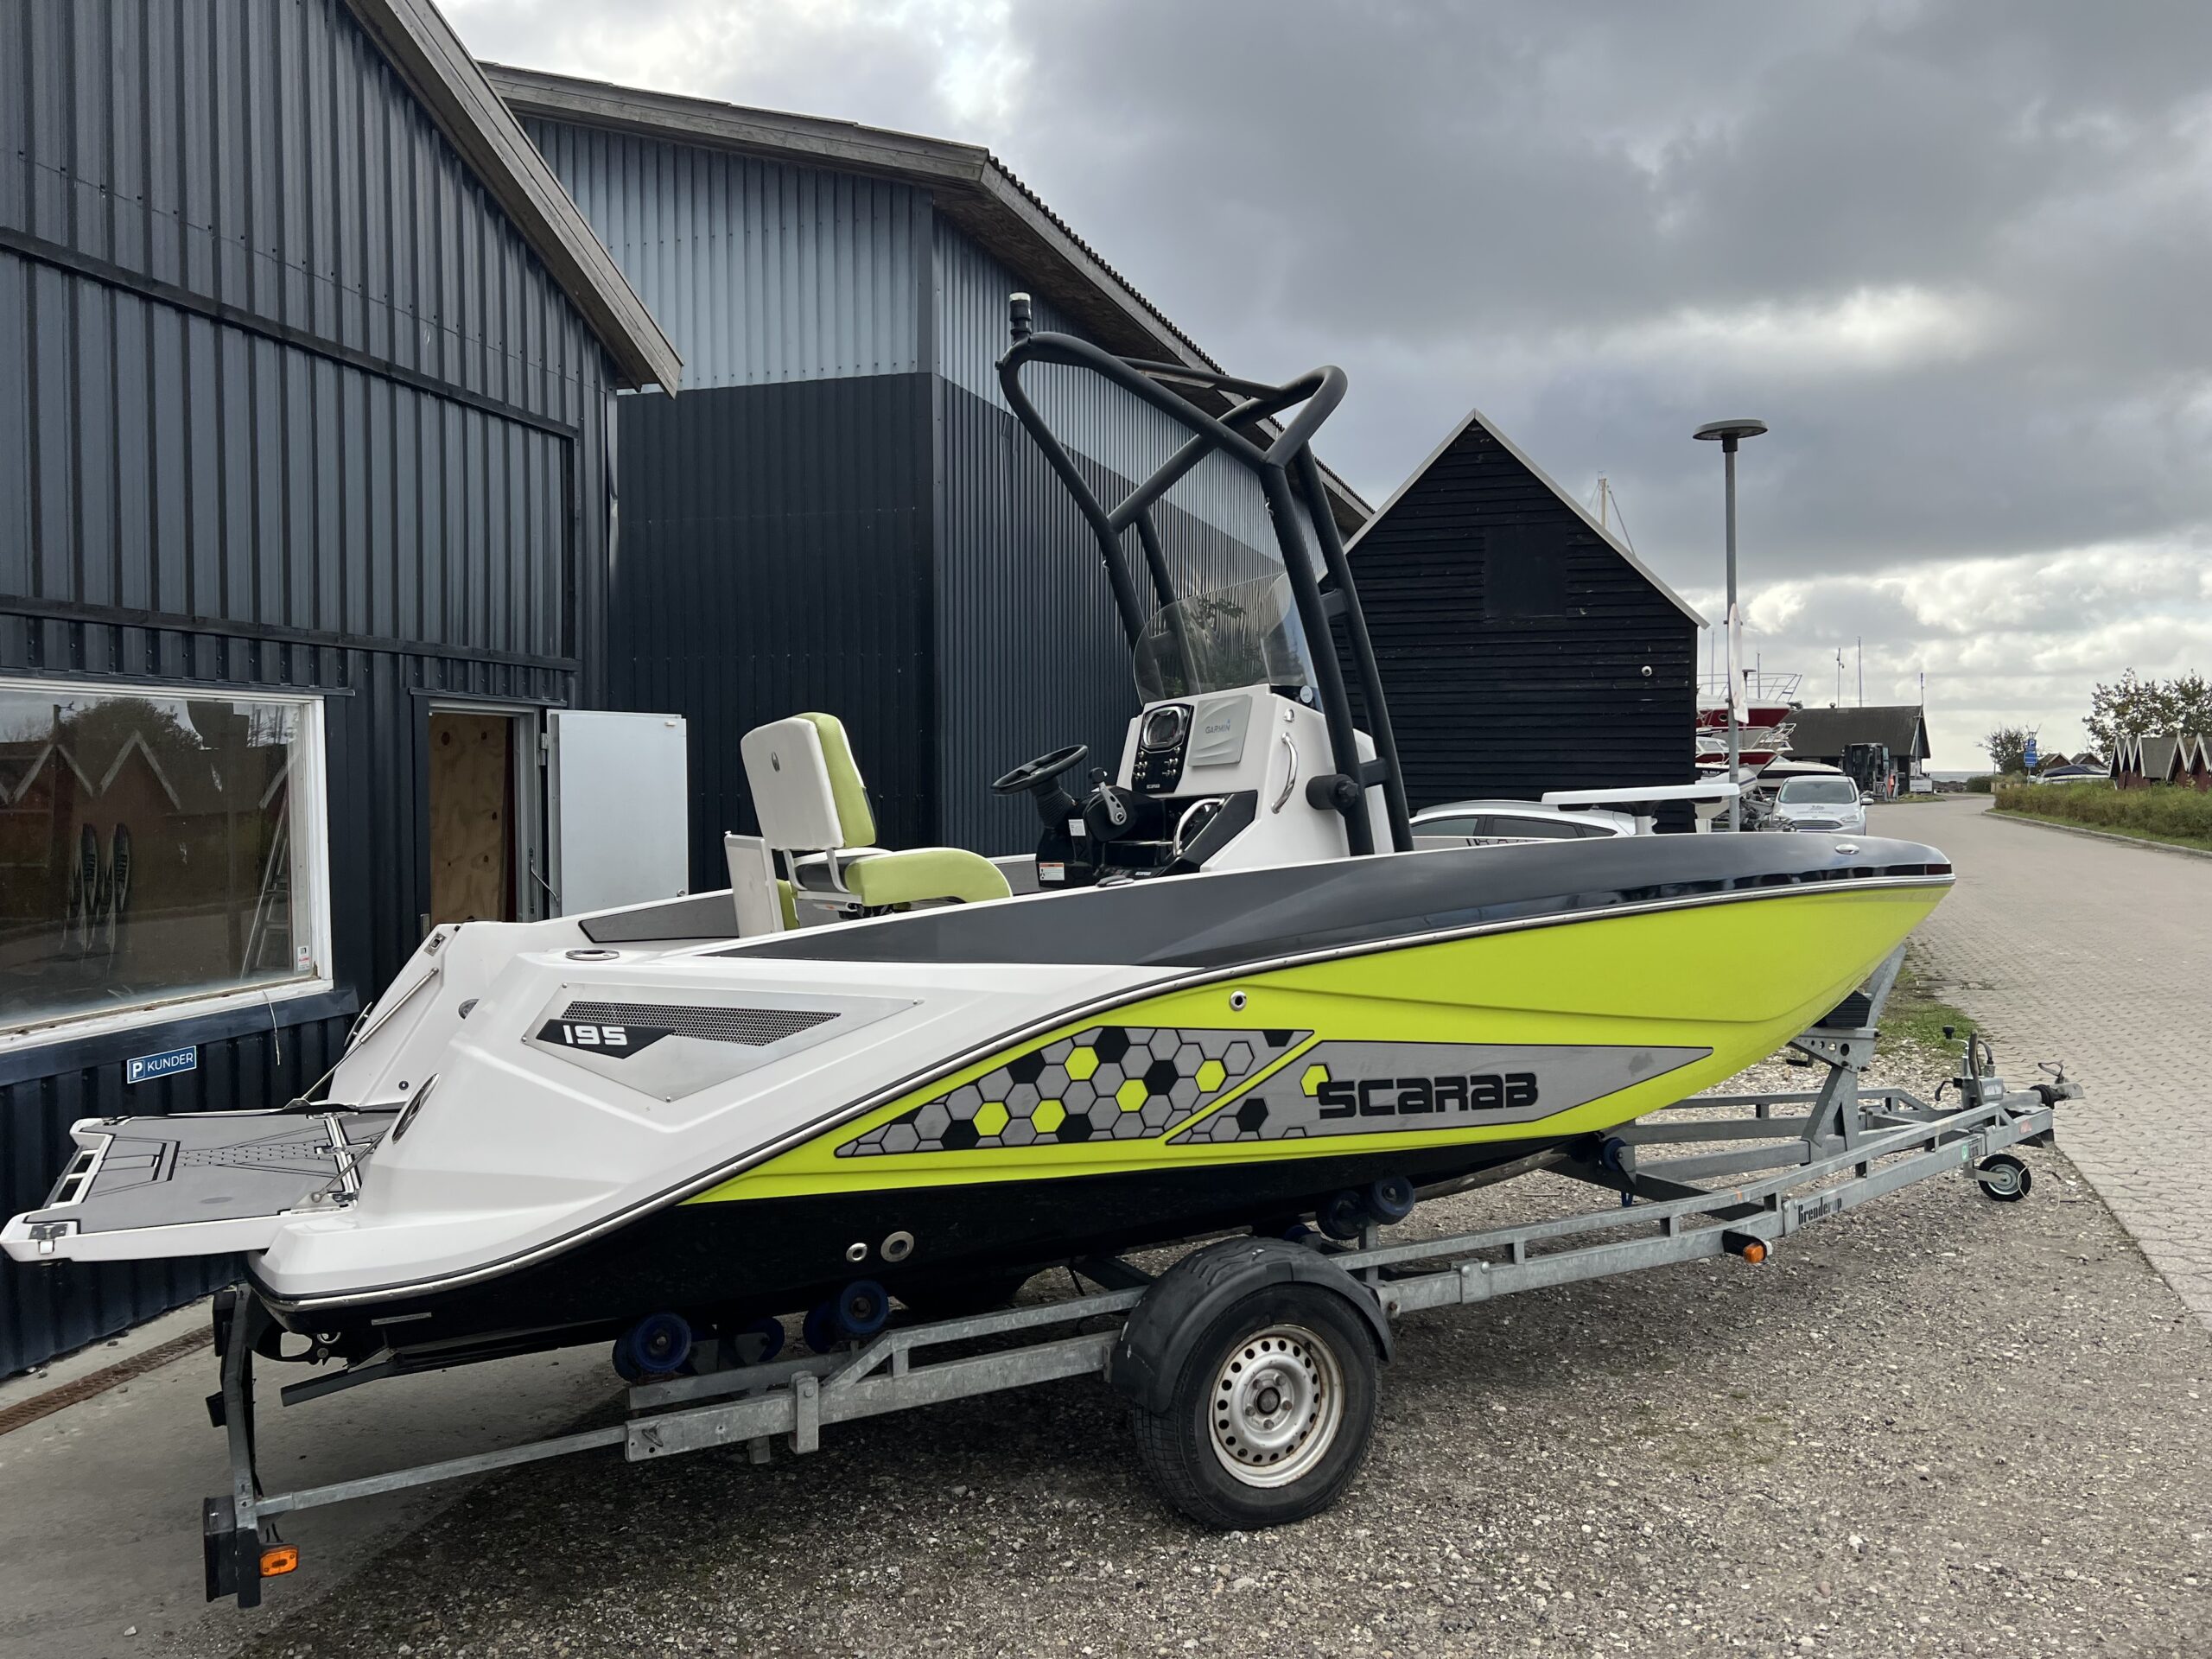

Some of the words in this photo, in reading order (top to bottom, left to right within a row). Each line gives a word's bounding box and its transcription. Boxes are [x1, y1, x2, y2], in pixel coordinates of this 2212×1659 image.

[1205, 724, 1231, 734] GARMIN
[563, 1025, 628, 1046] 195
[132, 1062, 143, 1078] P
[147, 1052, 194, 1071] KUNDER
[1316, 1072, 1539, 1120] SCARAB
